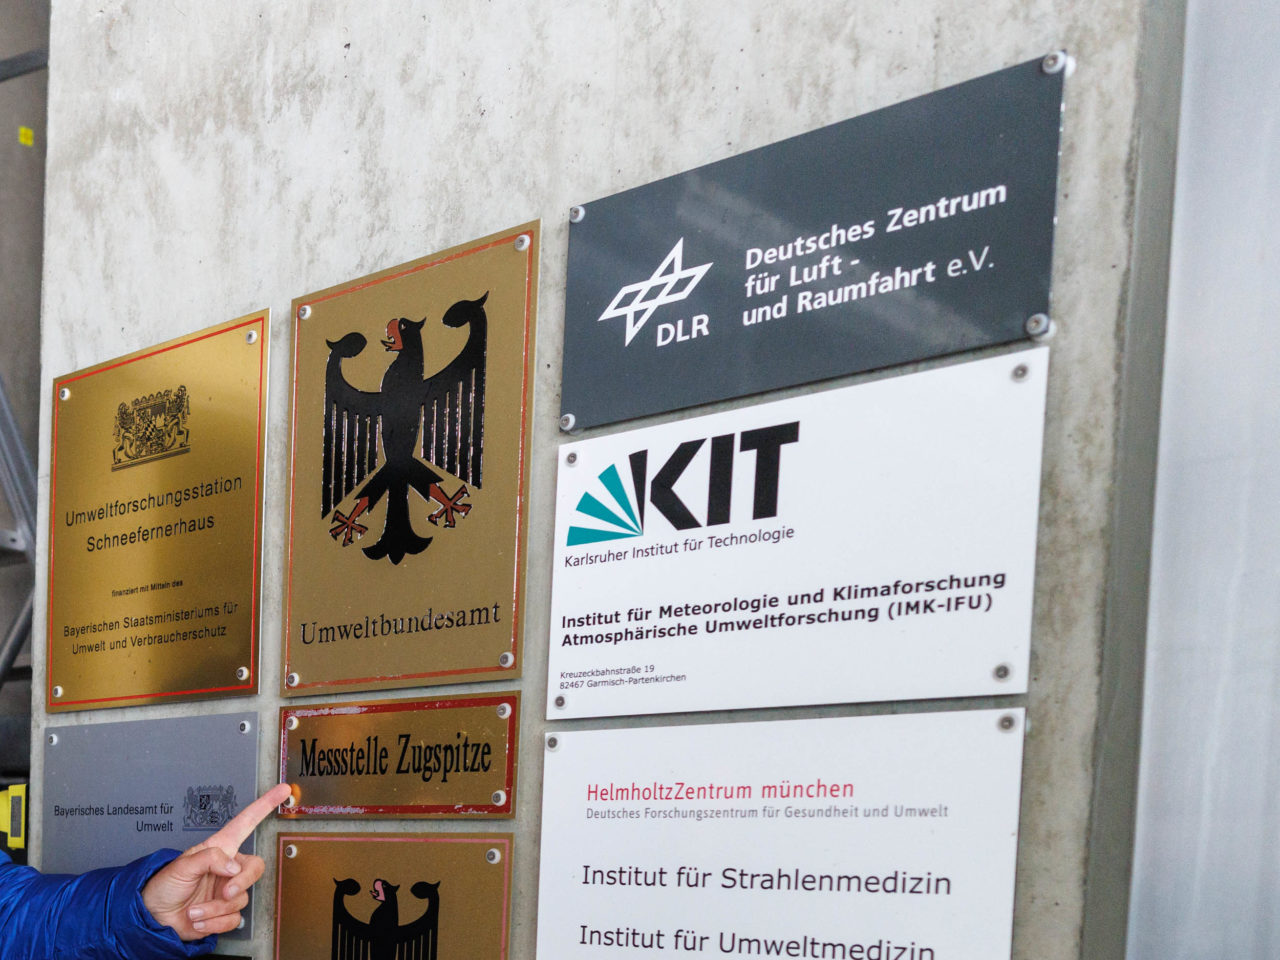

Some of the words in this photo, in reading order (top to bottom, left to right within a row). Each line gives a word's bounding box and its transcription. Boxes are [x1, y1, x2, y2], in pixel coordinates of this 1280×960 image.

[745, 219, 875, 271] Deutsches
[886, 184, 1007, 234] Zentrum
[742, 299, 788, 328] und
[797, 260, 937, 314] Raumfahrt
[946, 246, 995, 279] e.V.
[744, 272, 779, 298] für
[789, 253, 843, 289] Luft
[656, 313, 710, 348] DLR
[628, 420, 801, 537] KIT
[65, 476, 242, 527] Umweltforschungsstation
[86, 515, 215, 552] Schneefernerhaus
[564, 546, 629, 567] Karlsruher
[632, 541, 680, 559] Institut
[683, 538, 703, 554] für
[707, 526, 796, 549] Technologie
[140, 584, 149, 593] mit
[561, 608, 623, 630] Institut
[626, 604, 653, 623] für
[658, 592, 780, 620] Meteorologie
[787, 588, 825, 606] und
[832, 571, 1007, 601] Klimaforschung
[63, 618, 120, 638] Bayerischen
[123, 604, 220, 629] Staatsministeriums
[223, 601, 239, 616] für
[300, 601, 501, 645] Umweltbundesamt
[561, 620, 699, 647] Atmosphärische
[705, 604, 880, 634] Umweltforschung
[887, 591, 994, 623] (IMK-IFU)
[72, 638, 106, 655] Umwelt
[109, 637, 127, 651] und
[130, 626, 227, 648] Verbraucherschutz
[559, 680, 585, 690] 82467
[586, 673, 687, 688] Garmisch-Partenkirchen
[560, 665, 642, 679] Kreuzeckbahnstraße
[644, 664, 655, 673] 19
[299, 736, 389, 777] Messstelle
[396, 732, 492, 783] Zugspitze
[587, 781, 752, 801] HelmholtzZentrum
[761, 778, 854, 799] münchen
[54, 804, 105, 818] Bayerisches
[107, 802, 157, 816] Landesamt
[160, 803, 174, 815] für
[136, 820, 174, 832] Umwelt
[586, 807, 641, 819] Deutsches
[644, 807, 759, 821] Forschungszentrum
[762, 806, 781, 818] für
[784, 804, 859, 818] Gesundheit
[863, 804, 889, 818] und
[894, 804, 949, 818] Umwelt
[582, 865, 668, 888] Institut
[676, 866, 713, 888] für
[720, 867, 952, 895] Strahlenmedizin
[579, 925, 665, 950] Institut
[673, 929, 710, 952] für
